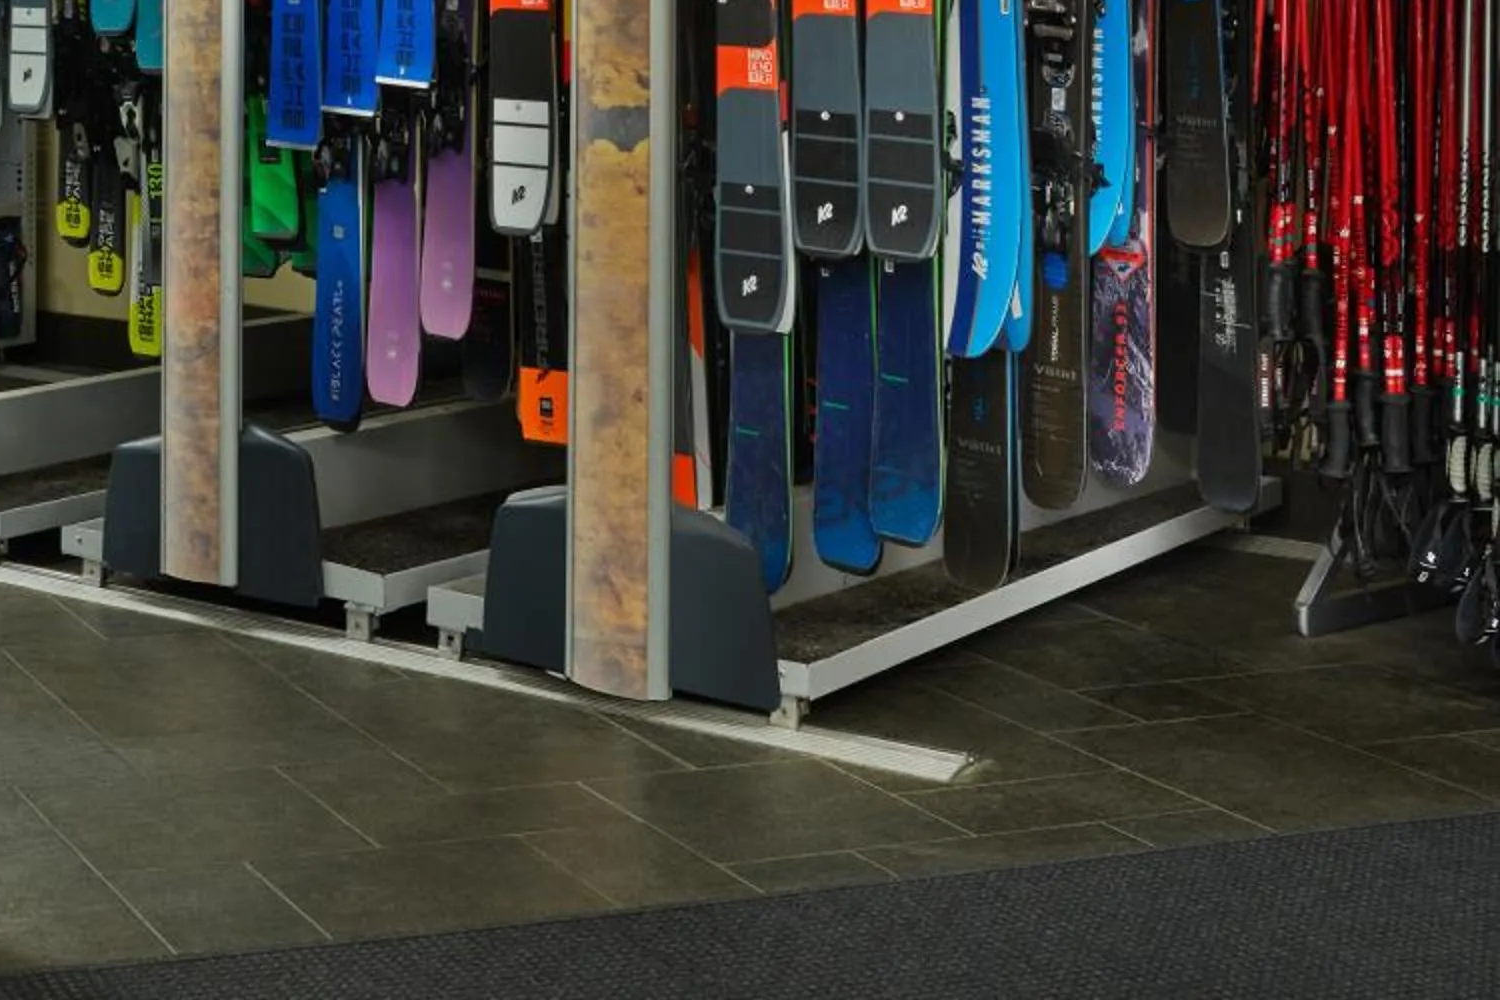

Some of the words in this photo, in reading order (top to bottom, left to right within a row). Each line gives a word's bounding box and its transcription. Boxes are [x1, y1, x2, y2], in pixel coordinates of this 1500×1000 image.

[971, 97, 992, 227] MARKSMAN
[817, 202, 833, 224] K2
[891, 204, 908, 227] K2
[742, 275, 758, 297] K2
